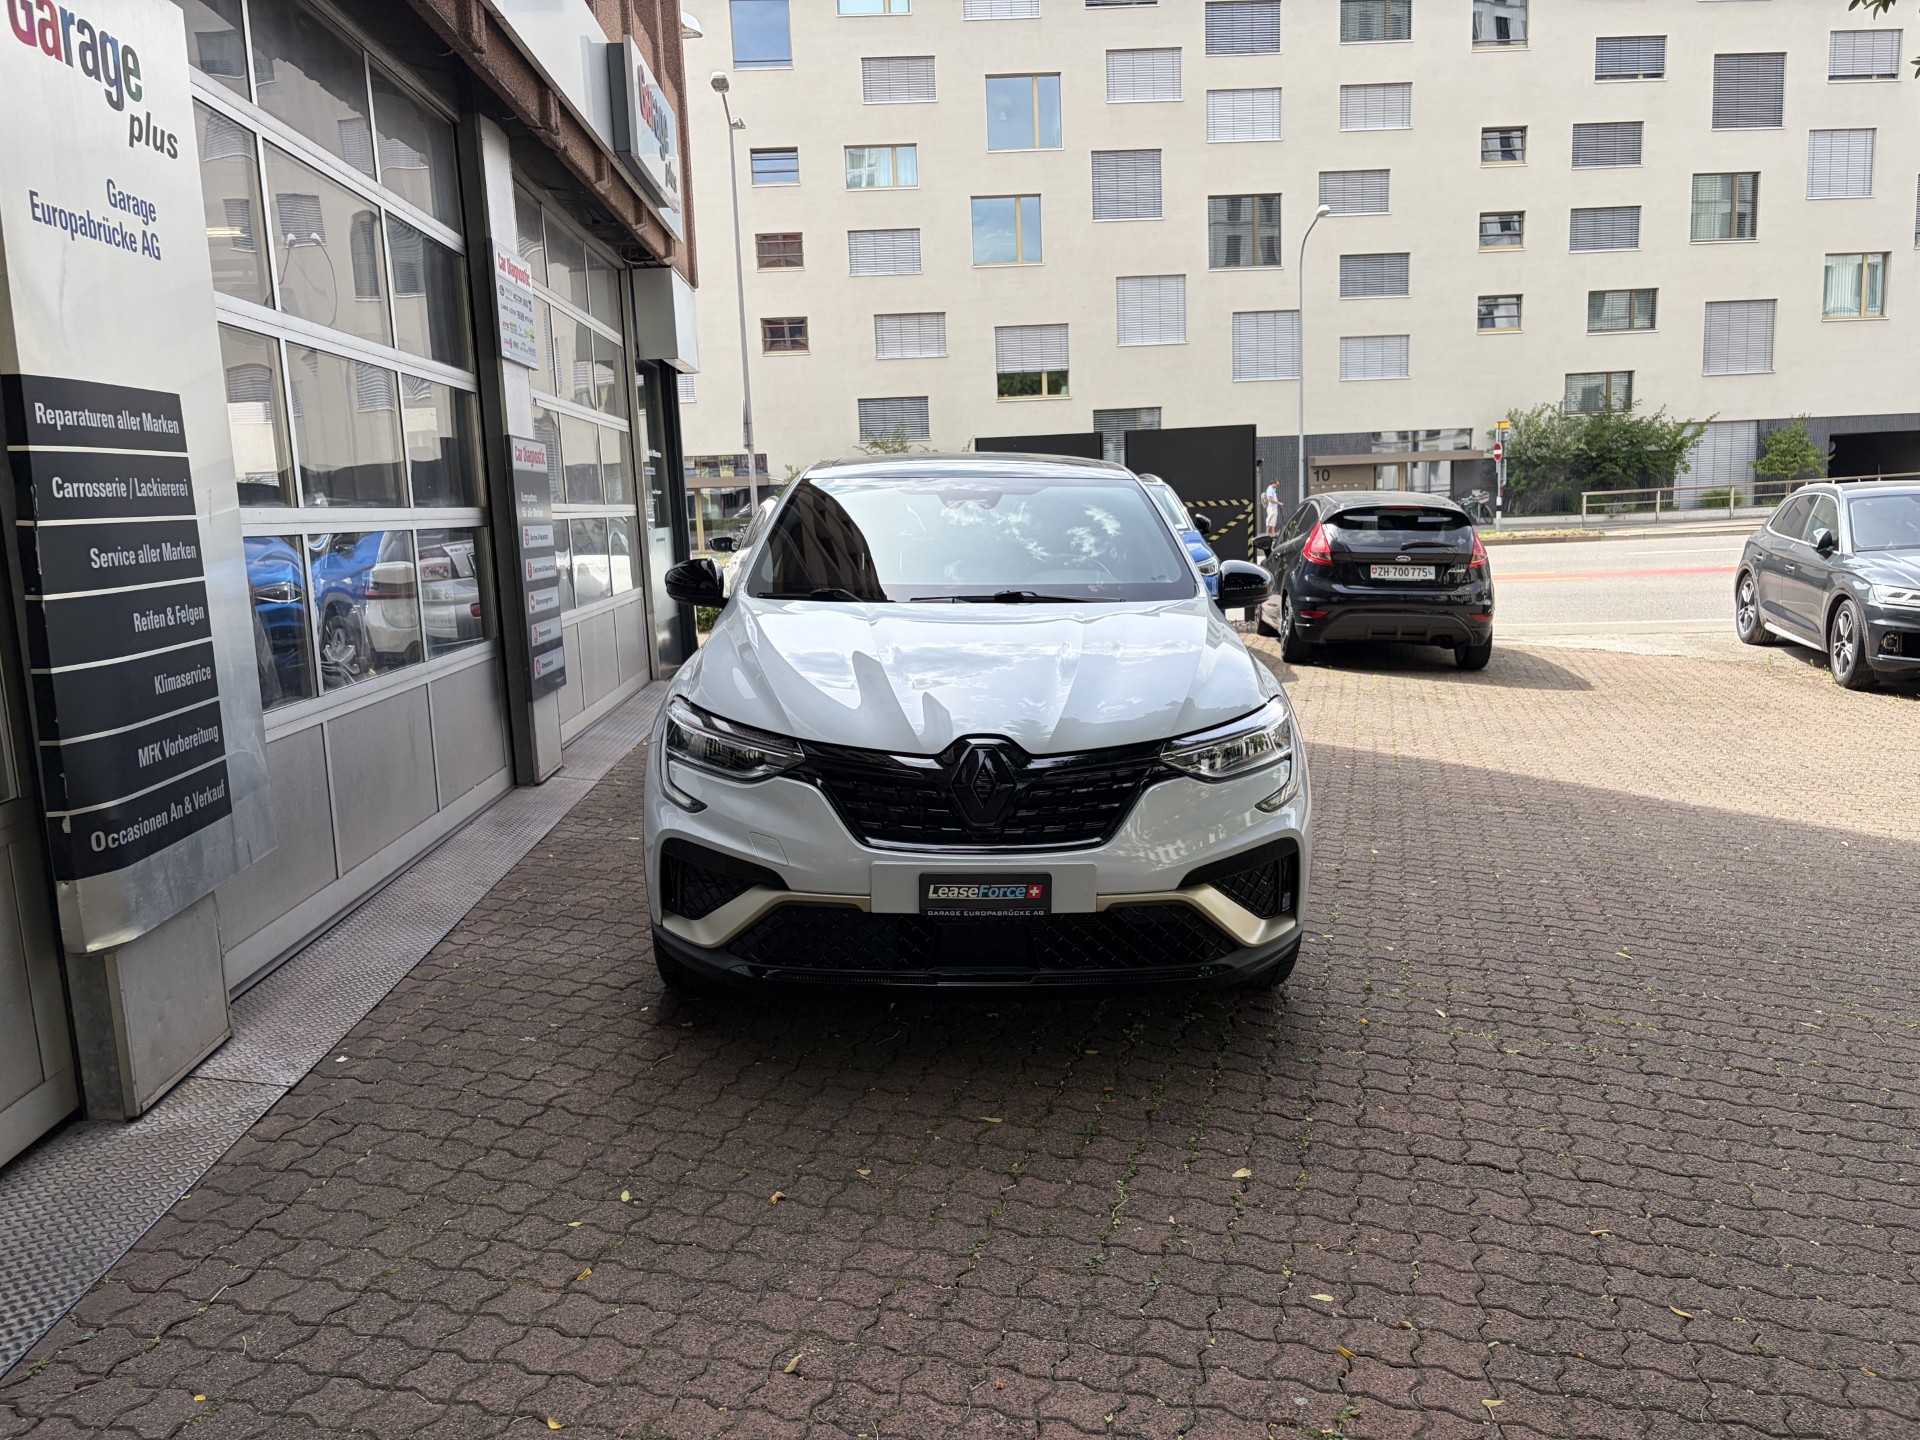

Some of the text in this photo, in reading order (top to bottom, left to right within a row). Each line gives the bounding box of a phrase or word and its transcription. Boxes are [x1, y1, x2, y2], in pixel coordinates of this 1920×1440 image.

[8, 0, 142, 111] Garage
[129, 111, 178, 159] plus
[106, 178, 157, 226] Garage
[28, 189, 161, 260] Europabrücke AG
[34, 402, 179, 434] Reparaturen aller Marken
[52, 476, 189, 499] Carrosserie / Lackiererei
[1313, 468, 1331, 482] 10
[90, 541, 197, 569] Service aller Marken
[133, 604, 205, 632] Reifen & Felgen
[154, 664, 212, 695] Klimaservice
[138, 722, 219, 768] MFK Vorbereitung
[90, 778, 225, 852] Occasionen An & Verkauf
[928, 884, 1026, 899] LeaseForce
[963, 908, 1031, 916] EUROPABRÜCKE
